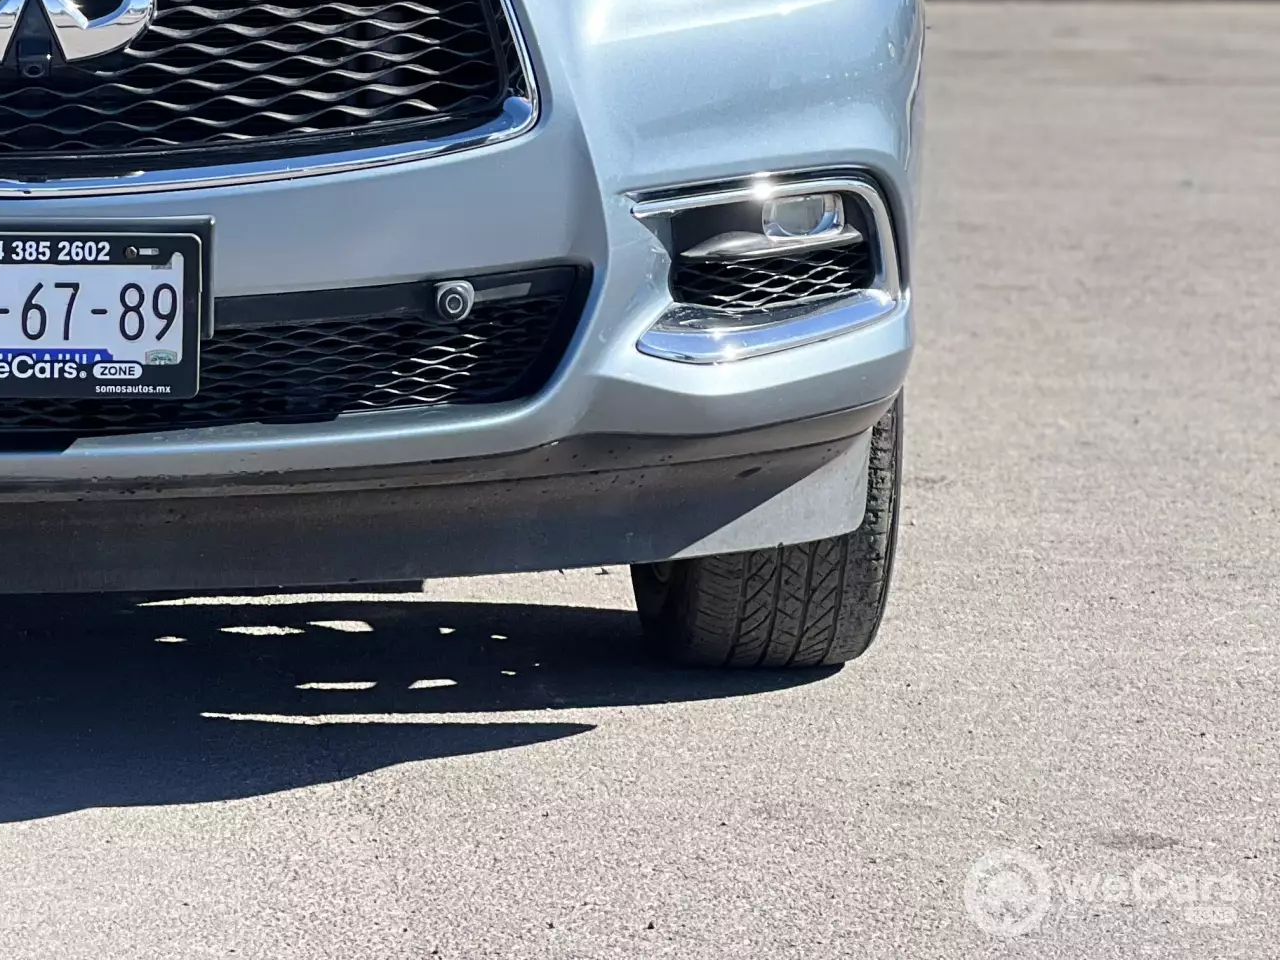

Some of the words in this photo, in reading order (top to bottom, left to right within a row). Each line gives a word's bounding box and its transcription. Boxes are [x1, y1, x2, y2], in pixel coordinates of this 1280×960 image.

[11, 240, 51, 261] 385
[57, 241, 111, 261] 2602
[99, 365, 137, 377] ZONE
[95, 383, 171, 394] somosautos.mx
